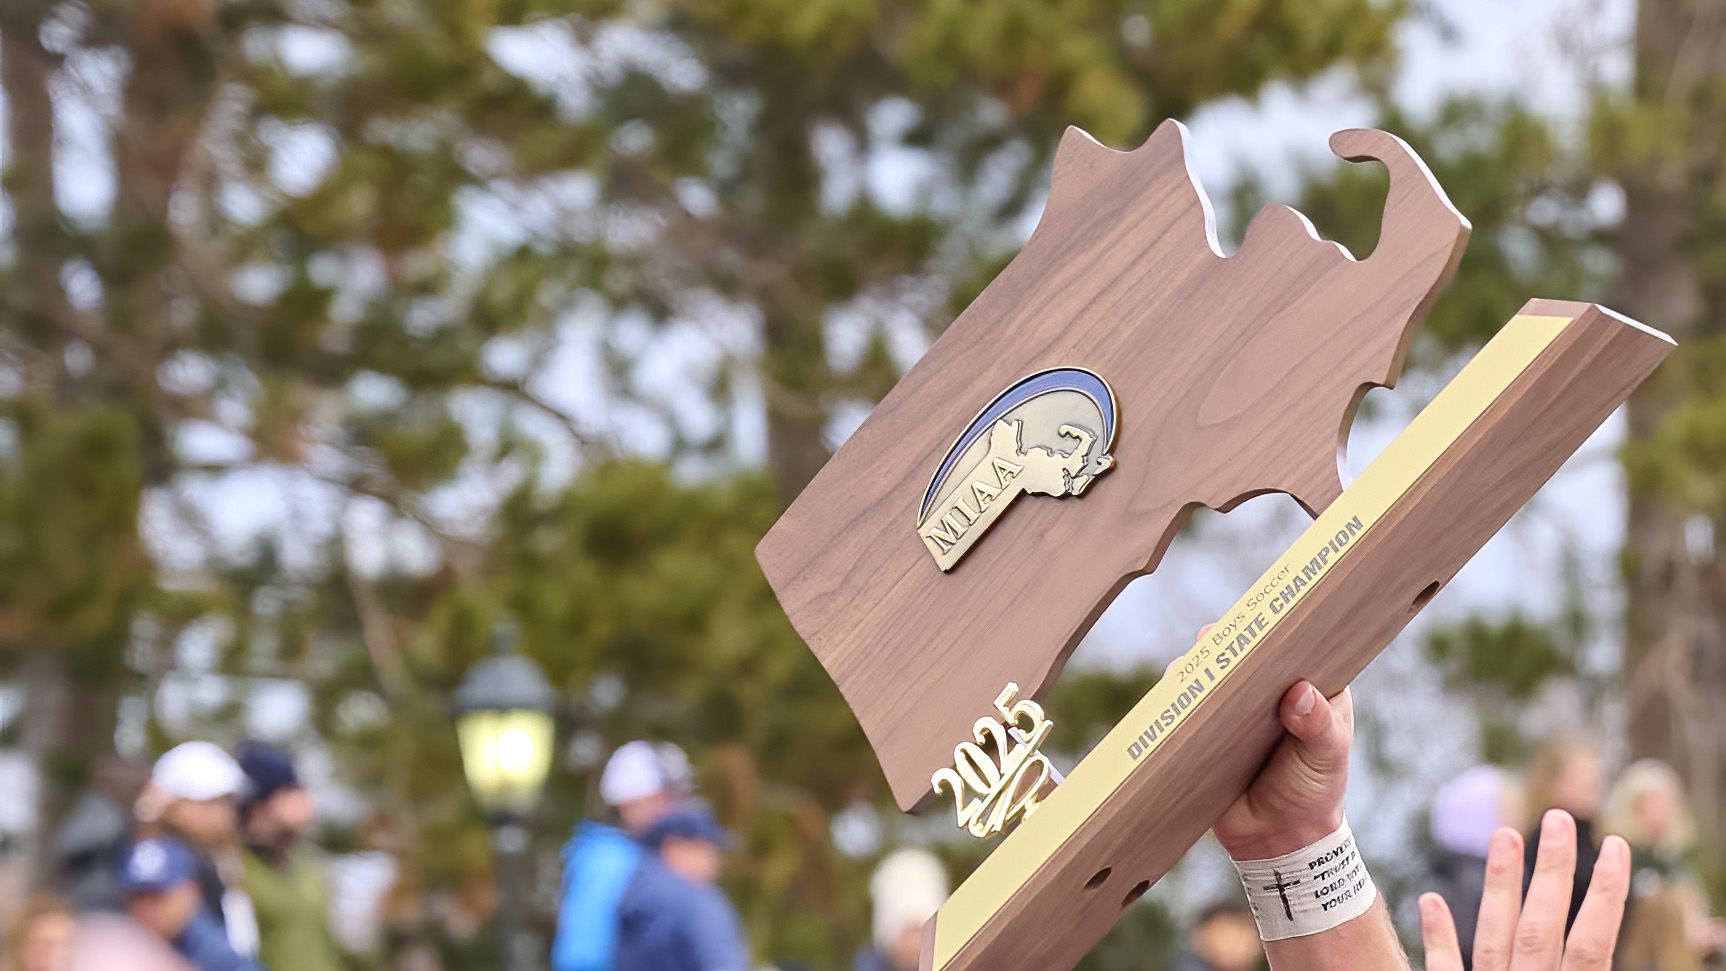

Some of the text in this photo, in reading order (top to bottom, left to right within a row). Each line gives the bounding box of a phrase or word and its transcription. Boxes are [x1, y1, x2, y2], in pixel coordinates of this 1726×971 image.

[926, 456, 1024, 555] MIAA
[1126, 678, 1205, 761] DIVISION
[1215, 612, 1270, 670] STATE
[1268, 515, 1364, 615] CHAMPION
[1176, 563, 1292, 683] 2025 Boys Soccer
[931, 681, 1045, 828] 2025
[1314, 878, 1345, 899] LORD
[1322, 889, 1353, 912] YOUR
